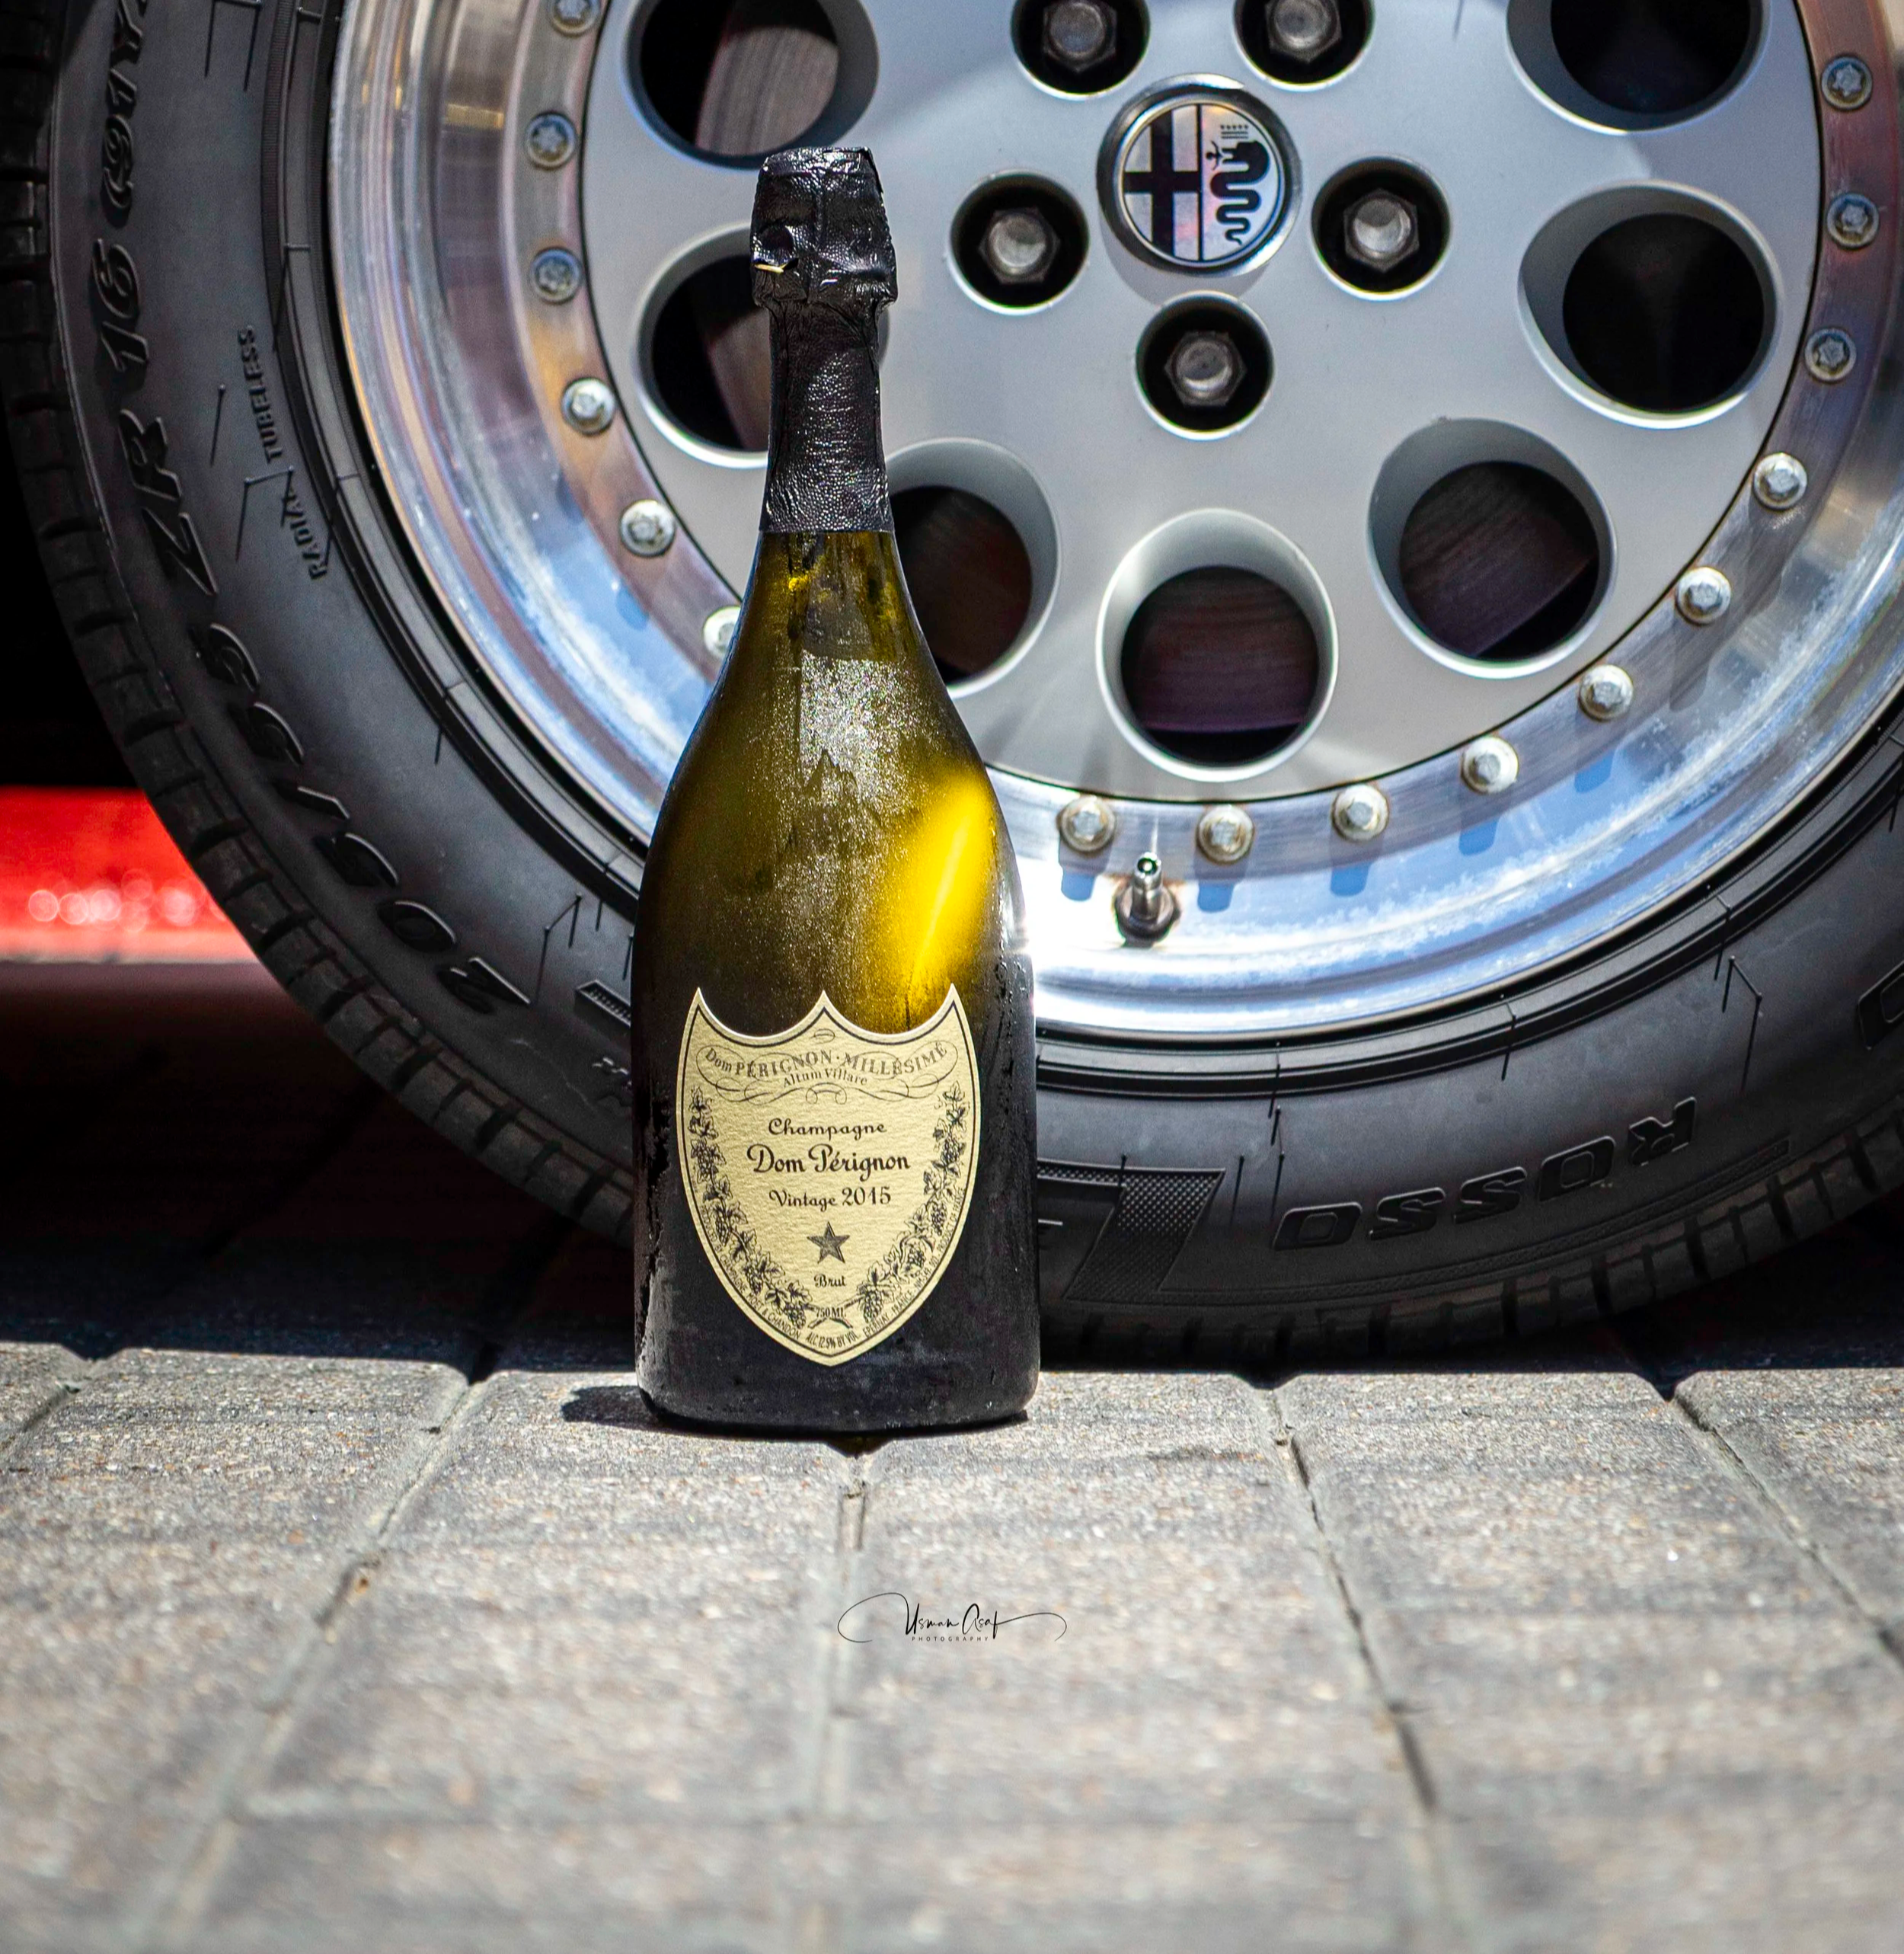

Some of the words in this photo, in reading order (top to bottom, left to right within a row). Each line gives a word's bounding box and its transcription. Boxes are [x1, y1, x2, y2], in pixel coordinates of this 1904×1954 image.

[92, 238, 149, 373] 16
[238, 325, 283, 463] TUBELESS
[119, 408, 219, 596] ZR
[705, 1047, 732, 1073] Dom
[784, 1070, 822, 1087] Altum
[825, 1068, 867, 1086] Villare
[768, 1118, 887, 1141] Champagne
[747, 1143, 806, 1173] Dom
[808, 1143, 911, 1182] Pérignon
[1273, 1096, 1698, 1251] ROSSO
[769, 1189, 838, 1212] Vintage
[842, 1186, 891, 1207] 2015
[813, 1274, 846, 1287] Brut
[719, 1255, 748, 1294] CHAMPAGNE
[768, 1312, 802, 1340] CHANDON
[838, 1335, 846, 1348] BY
